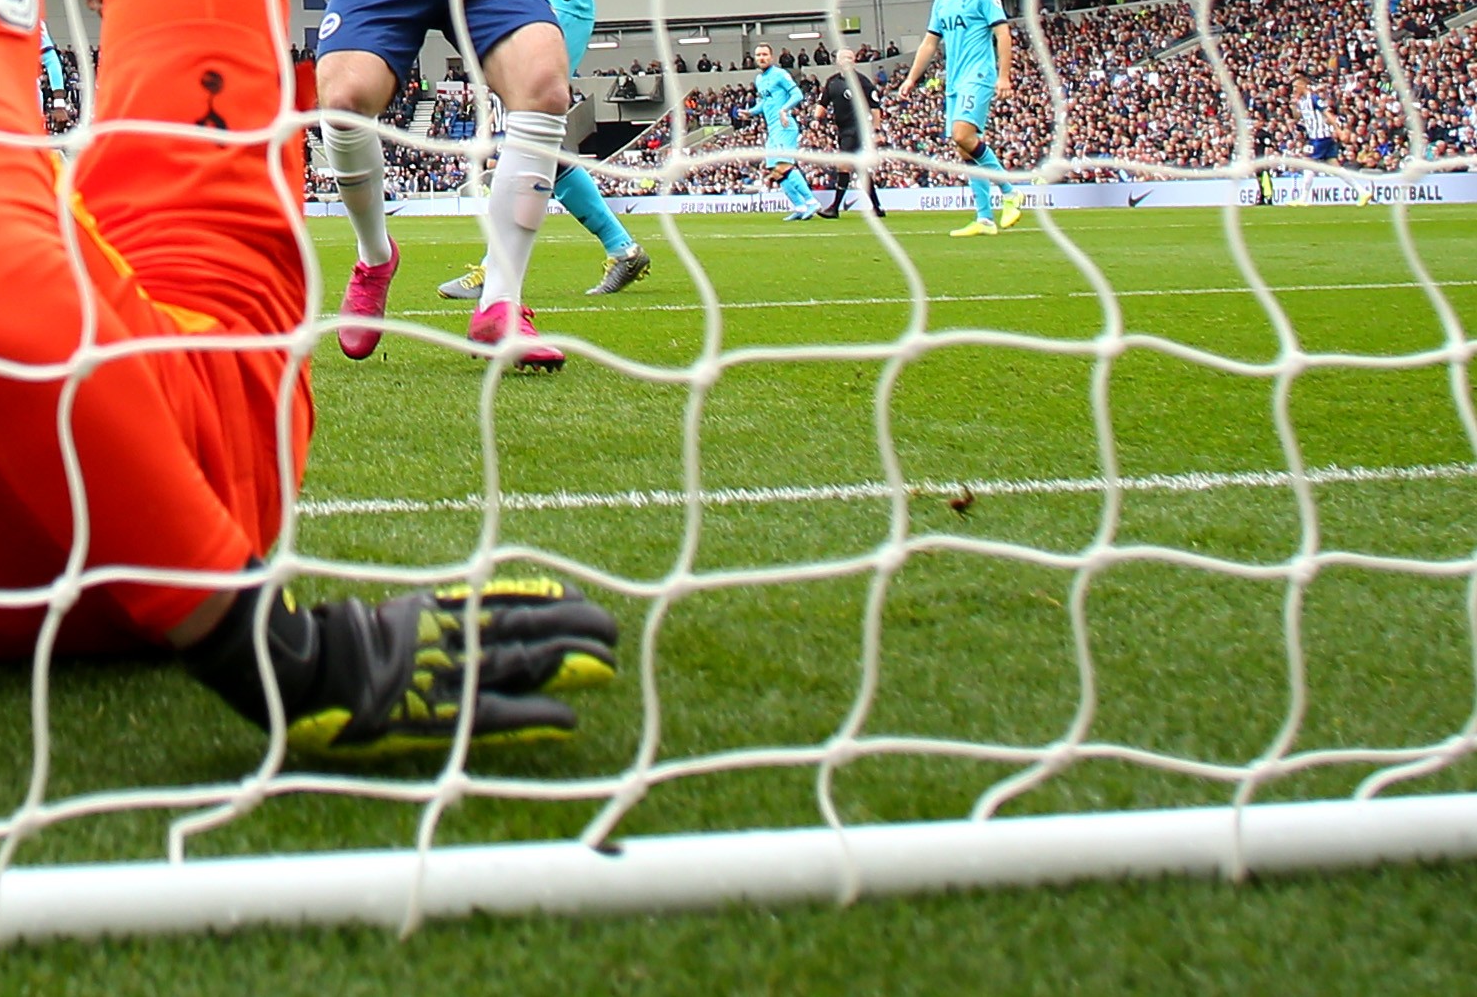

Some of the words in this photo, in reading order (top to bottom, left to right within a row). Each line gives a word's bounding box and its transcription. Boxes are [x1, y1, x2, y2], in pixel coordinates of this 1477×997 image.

[961, 94, 976, 110] 15
[920, 196, 940, 208] GEAR
[943, 195, 953, 208] UP
[1239, 189, 1264, 203] GEA
